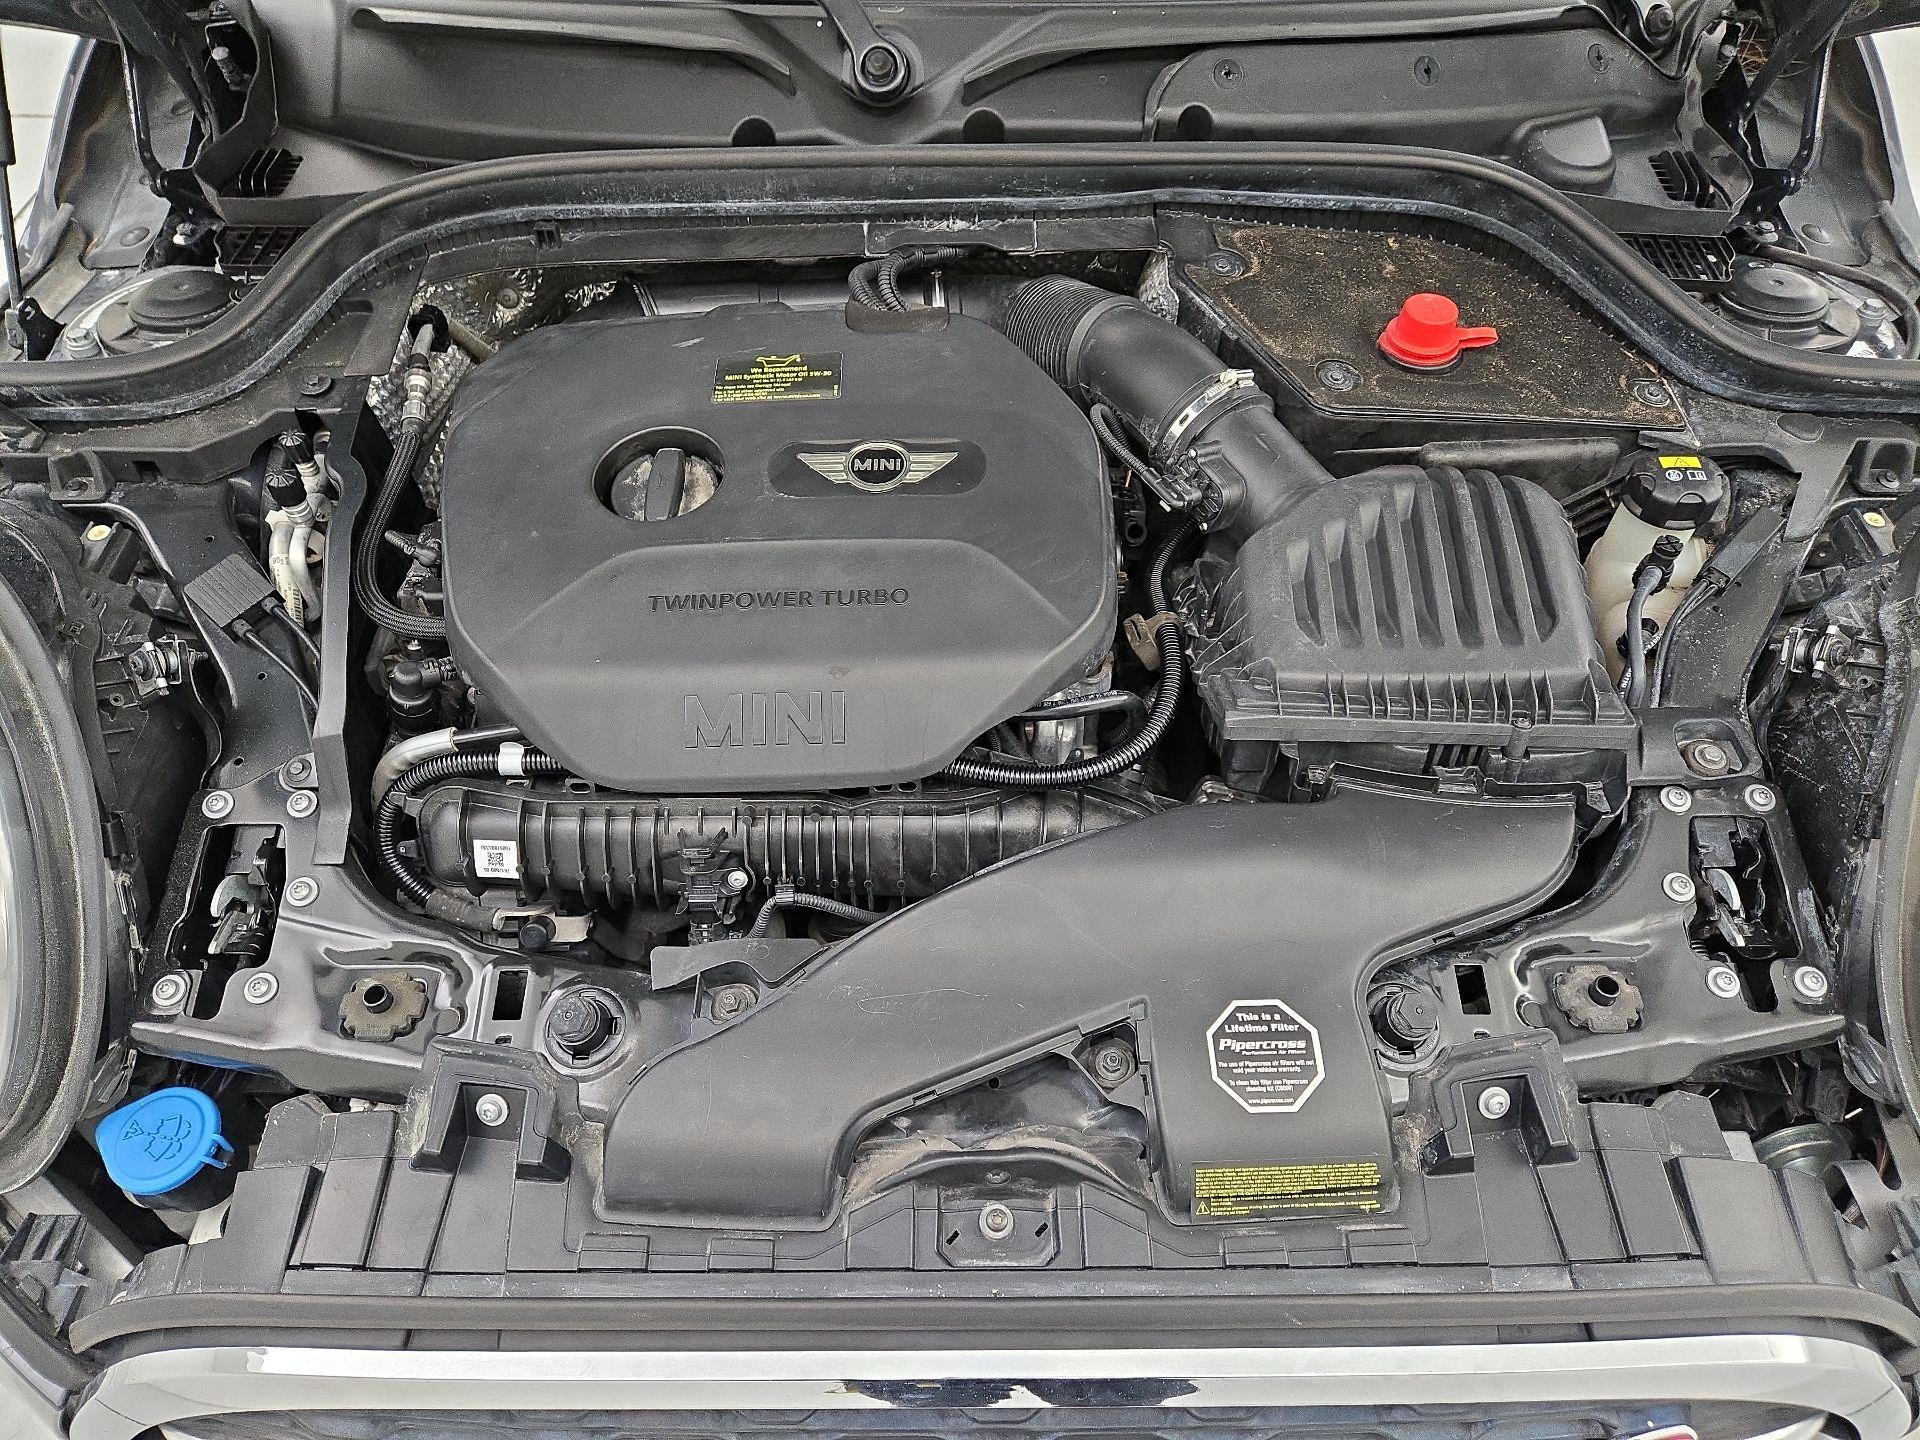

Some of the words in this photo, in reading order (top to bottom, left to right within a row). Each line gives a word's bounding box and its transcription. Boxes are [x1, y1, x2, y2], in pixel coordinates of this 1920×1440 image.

[854, 458, 902, 471] MINI
[648, 590, 813, 612] TWINPOWER
[821, 588, 910, 606] TURBO
[684, 690, 846, 749] MINI
[1236, 1012, 1259, 1021] This
[1224, 1024, 1268, 1033] Lifetime
[1270, 1023, 1300, 1032] Filter
[1218, 1038, 1306, 1052] Pipercross
